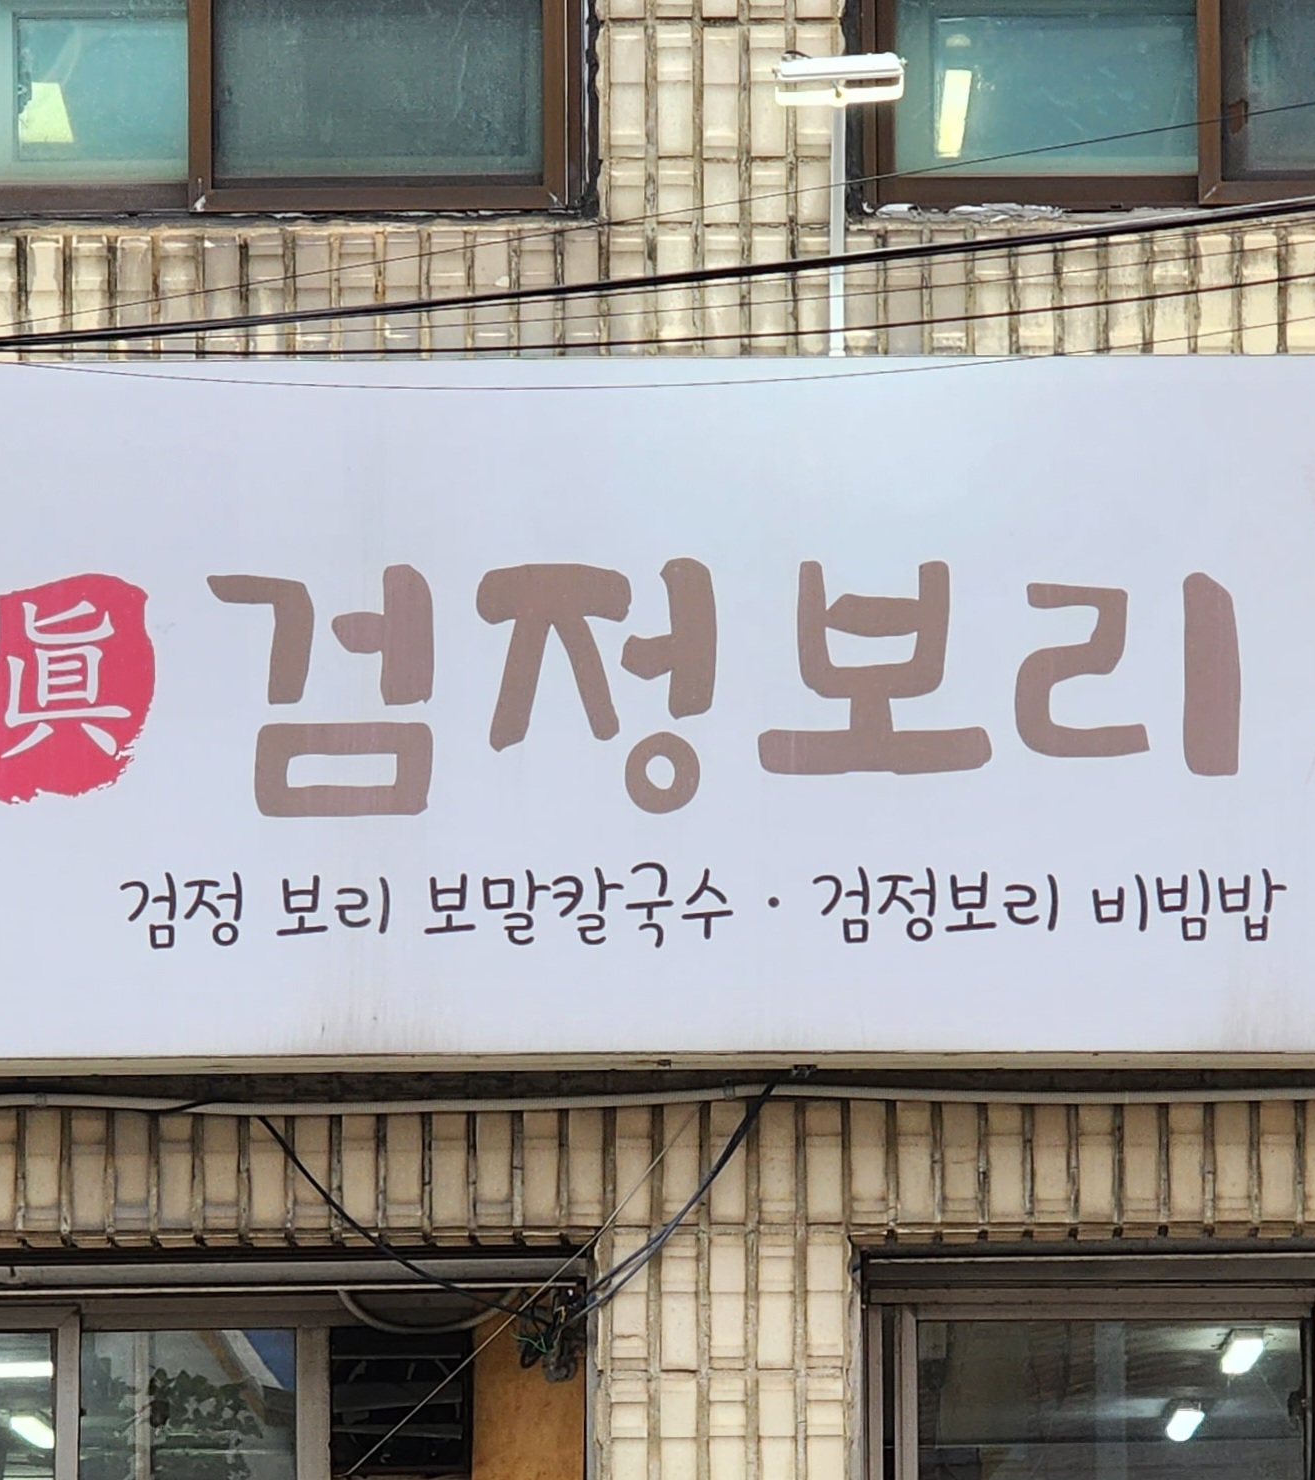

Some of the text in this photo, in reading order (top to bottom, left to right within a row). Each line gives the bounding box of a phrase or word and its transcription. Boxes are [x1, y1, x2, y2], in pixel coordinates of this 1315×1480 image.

[205, 557, 1241, 816] 검정보리
[119, 861, 1287, 948] 검정 보리 보말칼국수 검정보리 비빔밥
